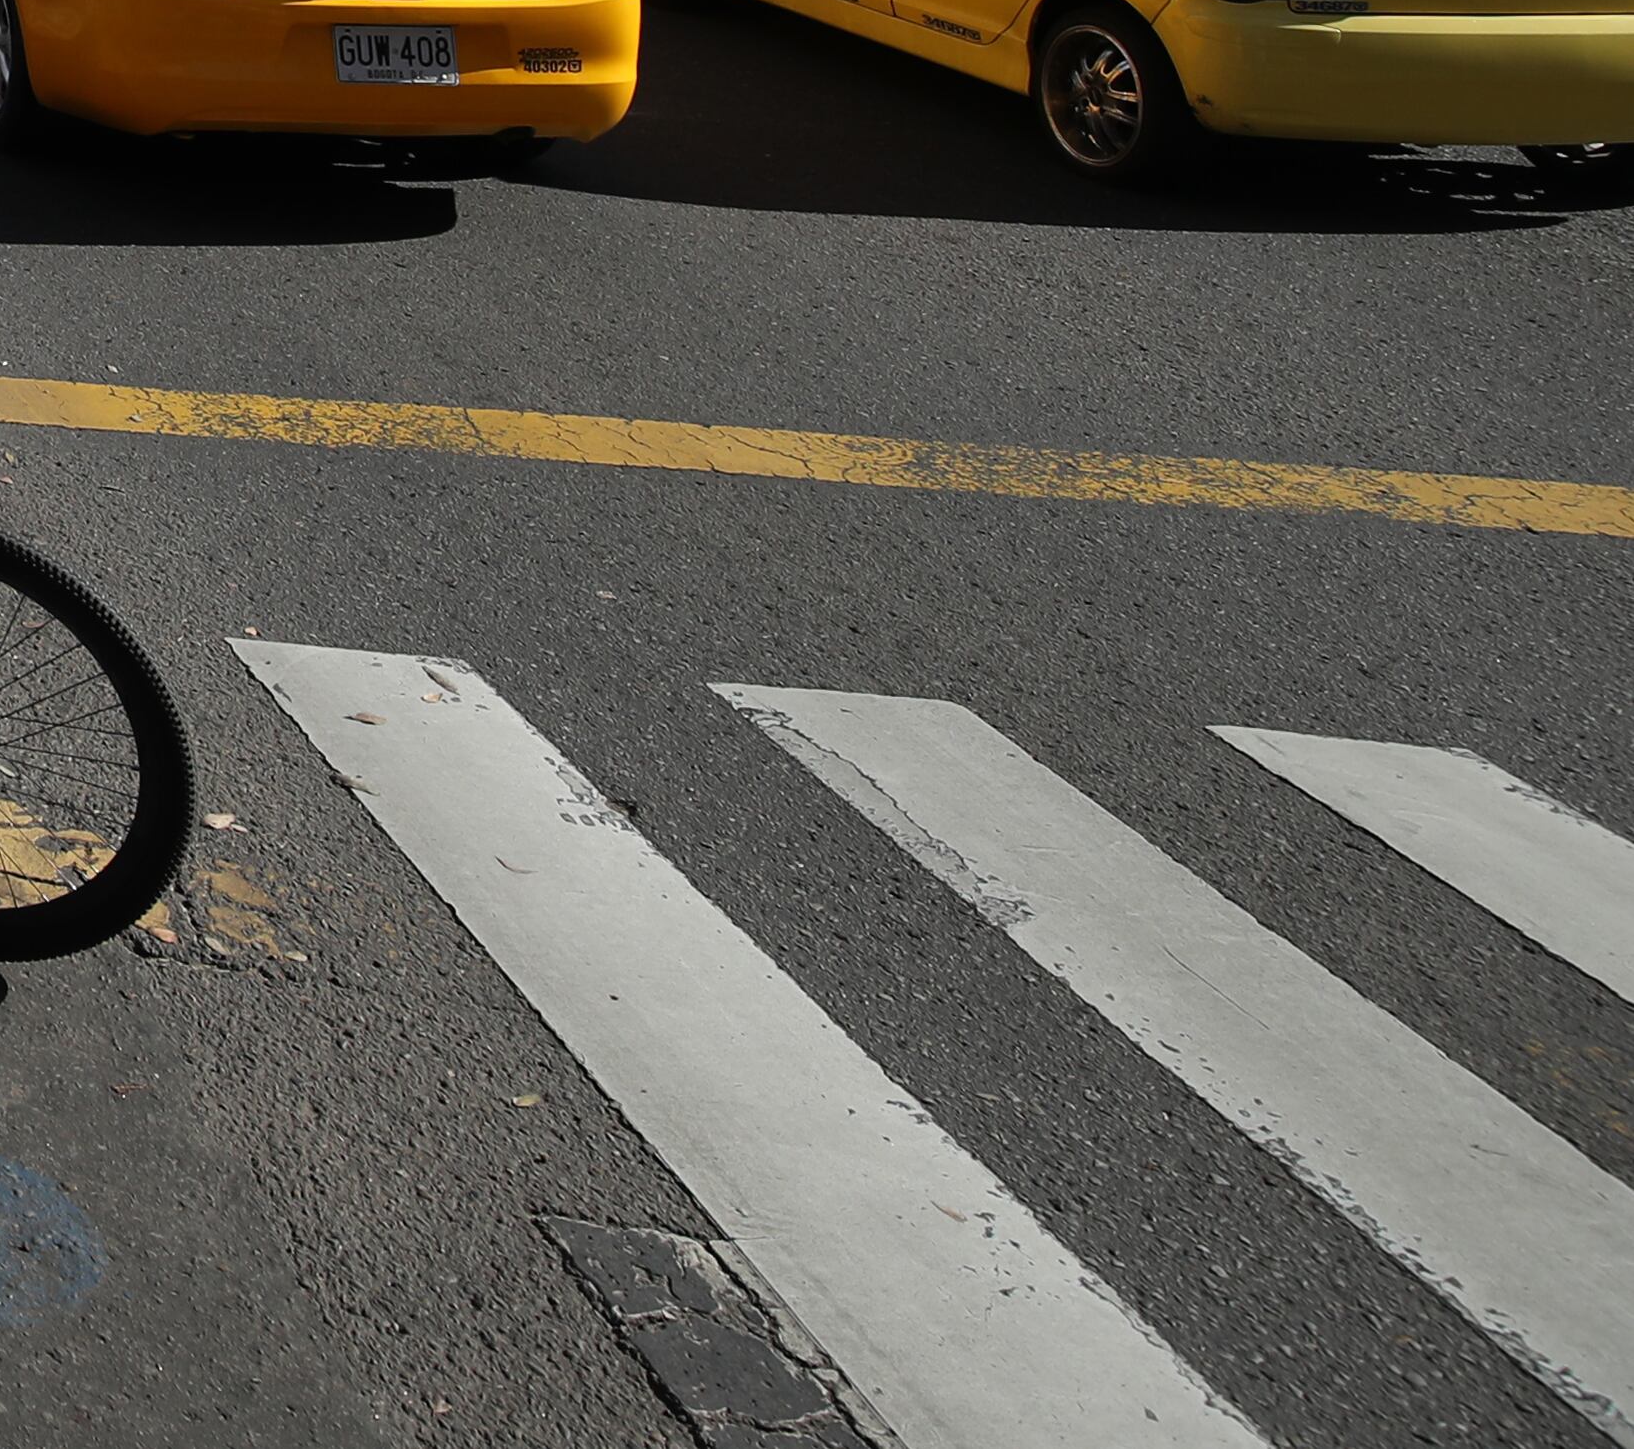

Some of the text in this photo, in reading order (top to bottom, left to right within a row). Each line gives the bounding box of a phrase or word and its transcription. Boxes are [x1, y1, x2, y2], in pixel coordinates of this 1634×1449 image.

[338, 34, 451, 68] GUW 408
[524, 59, 567, 74] 40302
